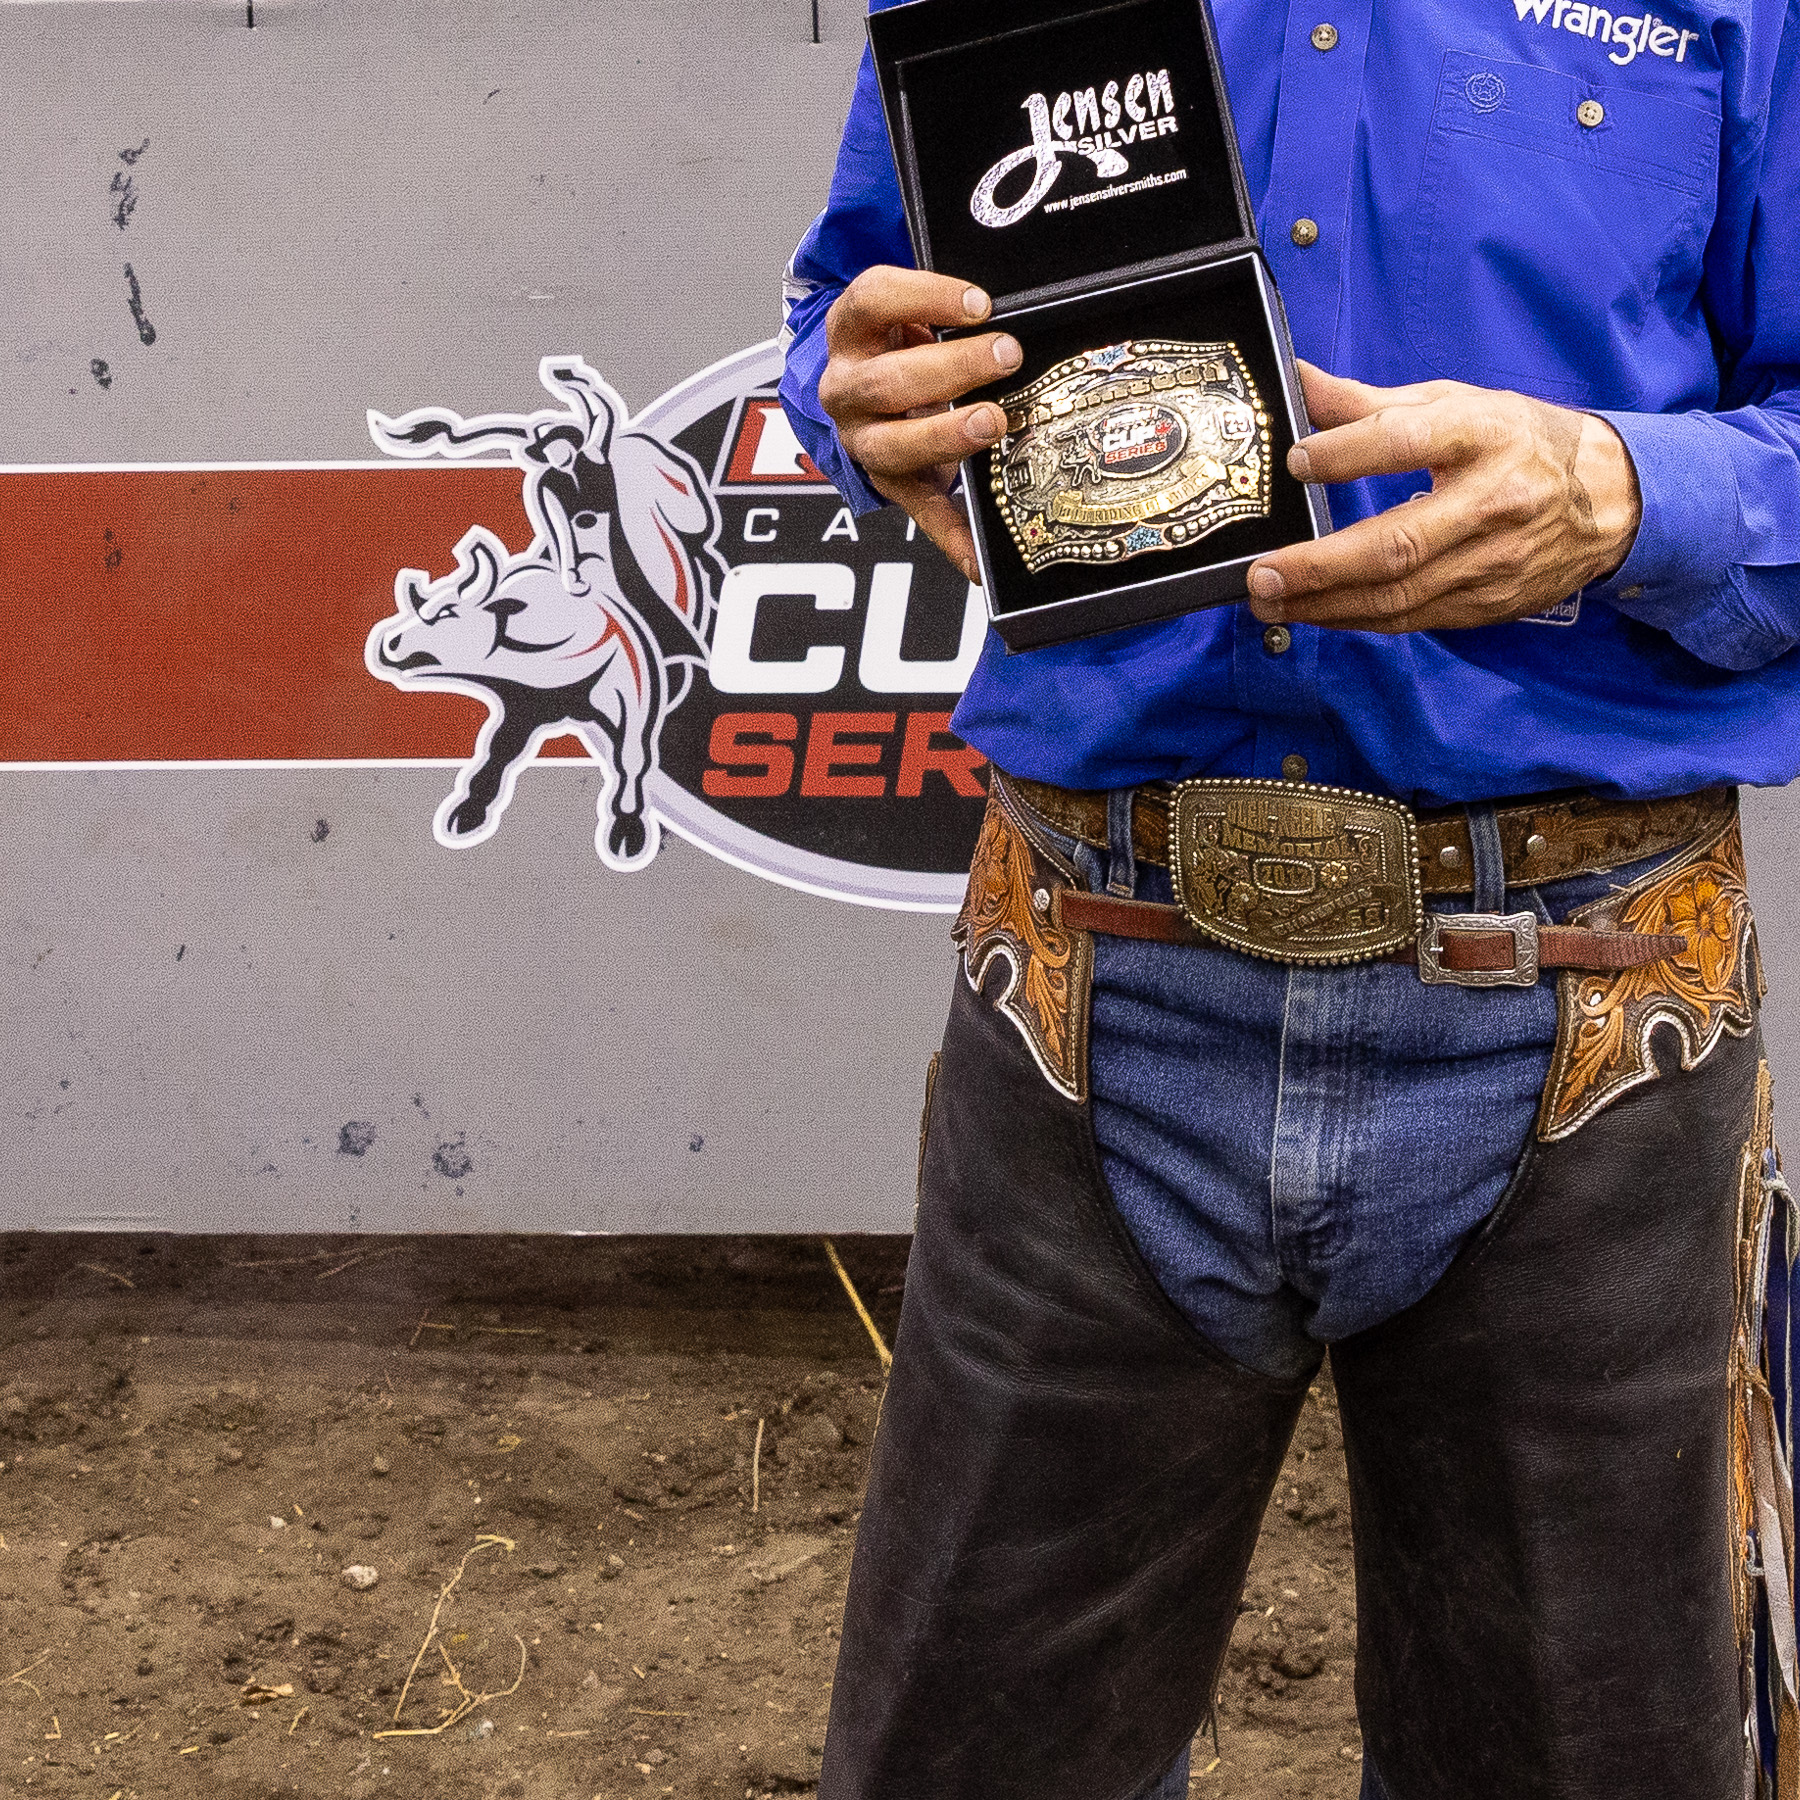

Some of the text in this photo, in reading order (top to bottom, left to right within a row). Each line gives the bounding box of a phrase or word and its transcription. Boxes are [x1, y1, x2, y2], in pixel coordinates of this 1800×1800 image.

[1077, 115, 1179, 155] SILVER
[1043, 168, 1188, 214] www.jensensilversmiths.com
[1102, 423, 1157, 453] CUP
[708, 562, 986, 694] CU
[701, 712, 988, 798] SER
